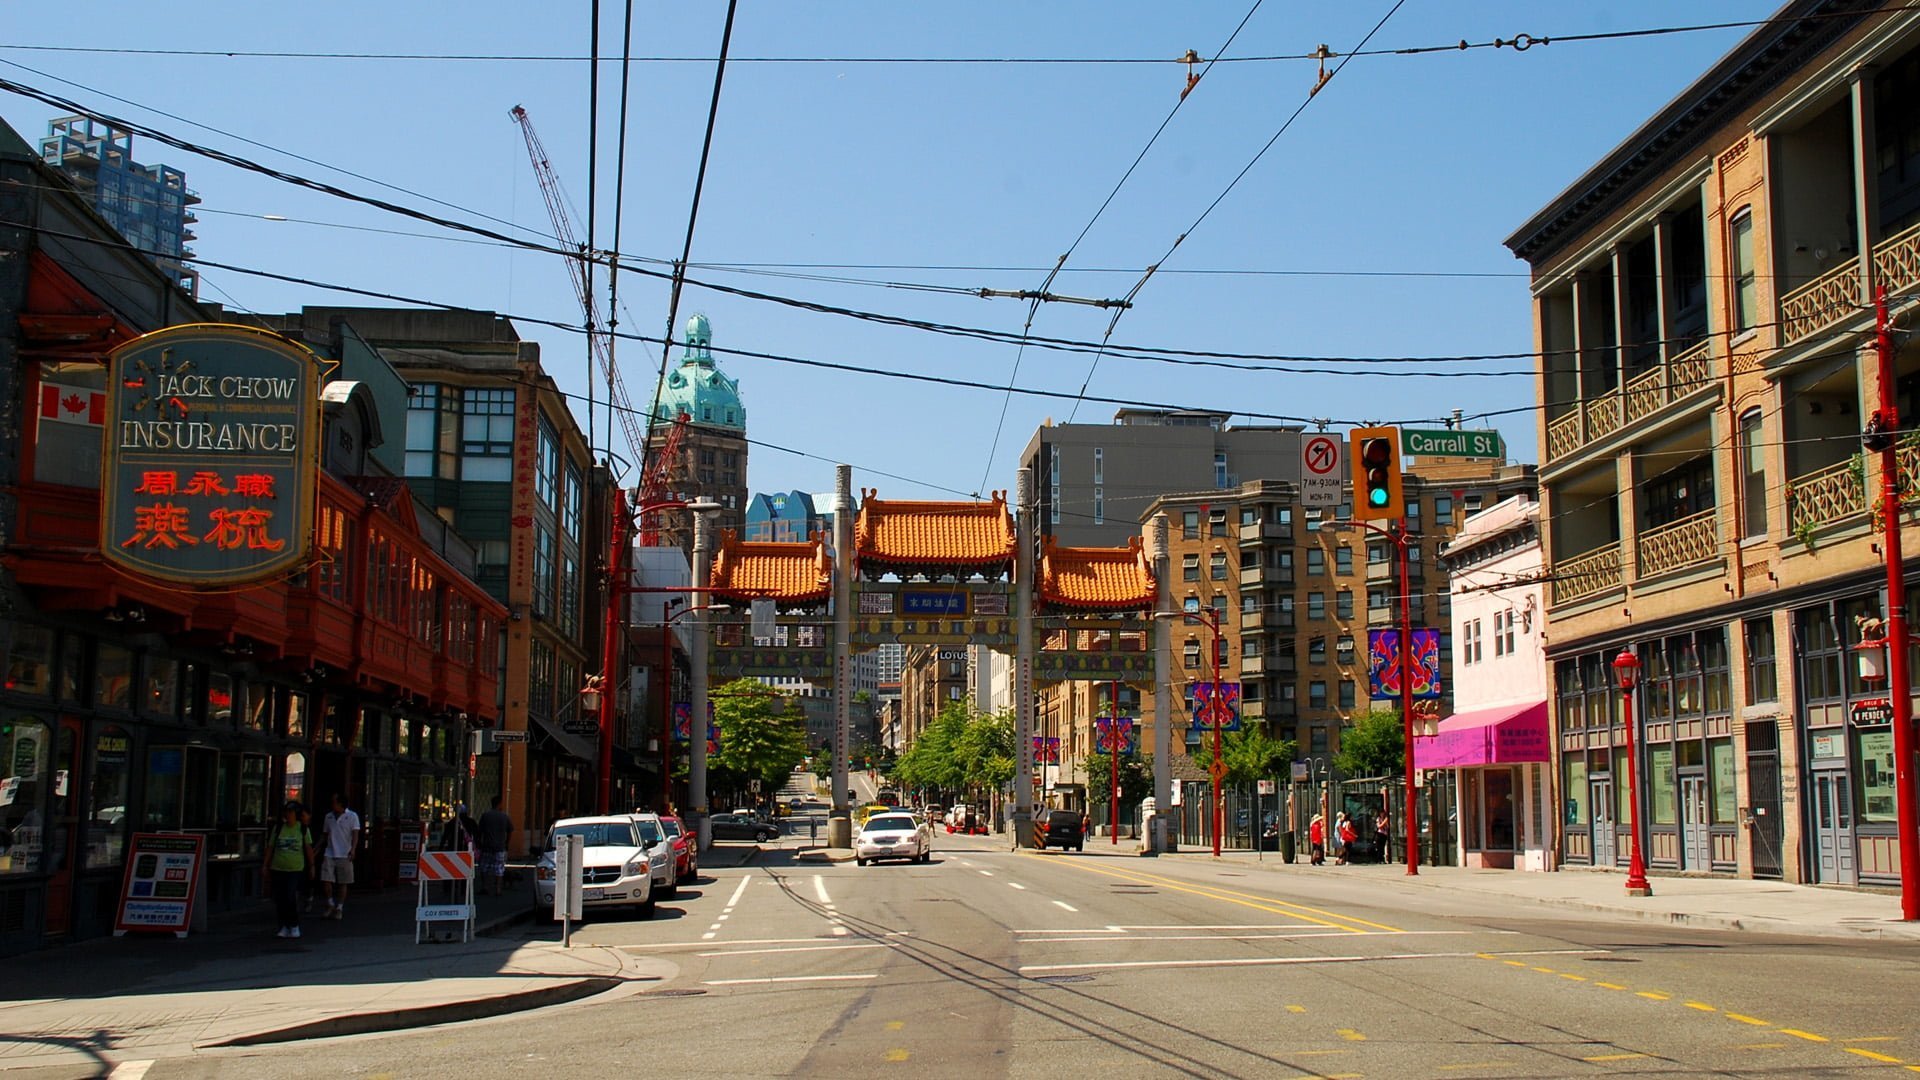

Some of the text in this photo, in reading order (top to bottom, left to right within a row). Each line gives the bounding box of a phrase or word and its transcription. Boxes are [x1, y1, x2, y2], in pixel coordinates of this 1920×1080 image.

[155, 374, 297, 400] JACK CHOW
[120, 420, 297, 452] INSURANCE
[1409, 433, 1493, 454] Carrall St
